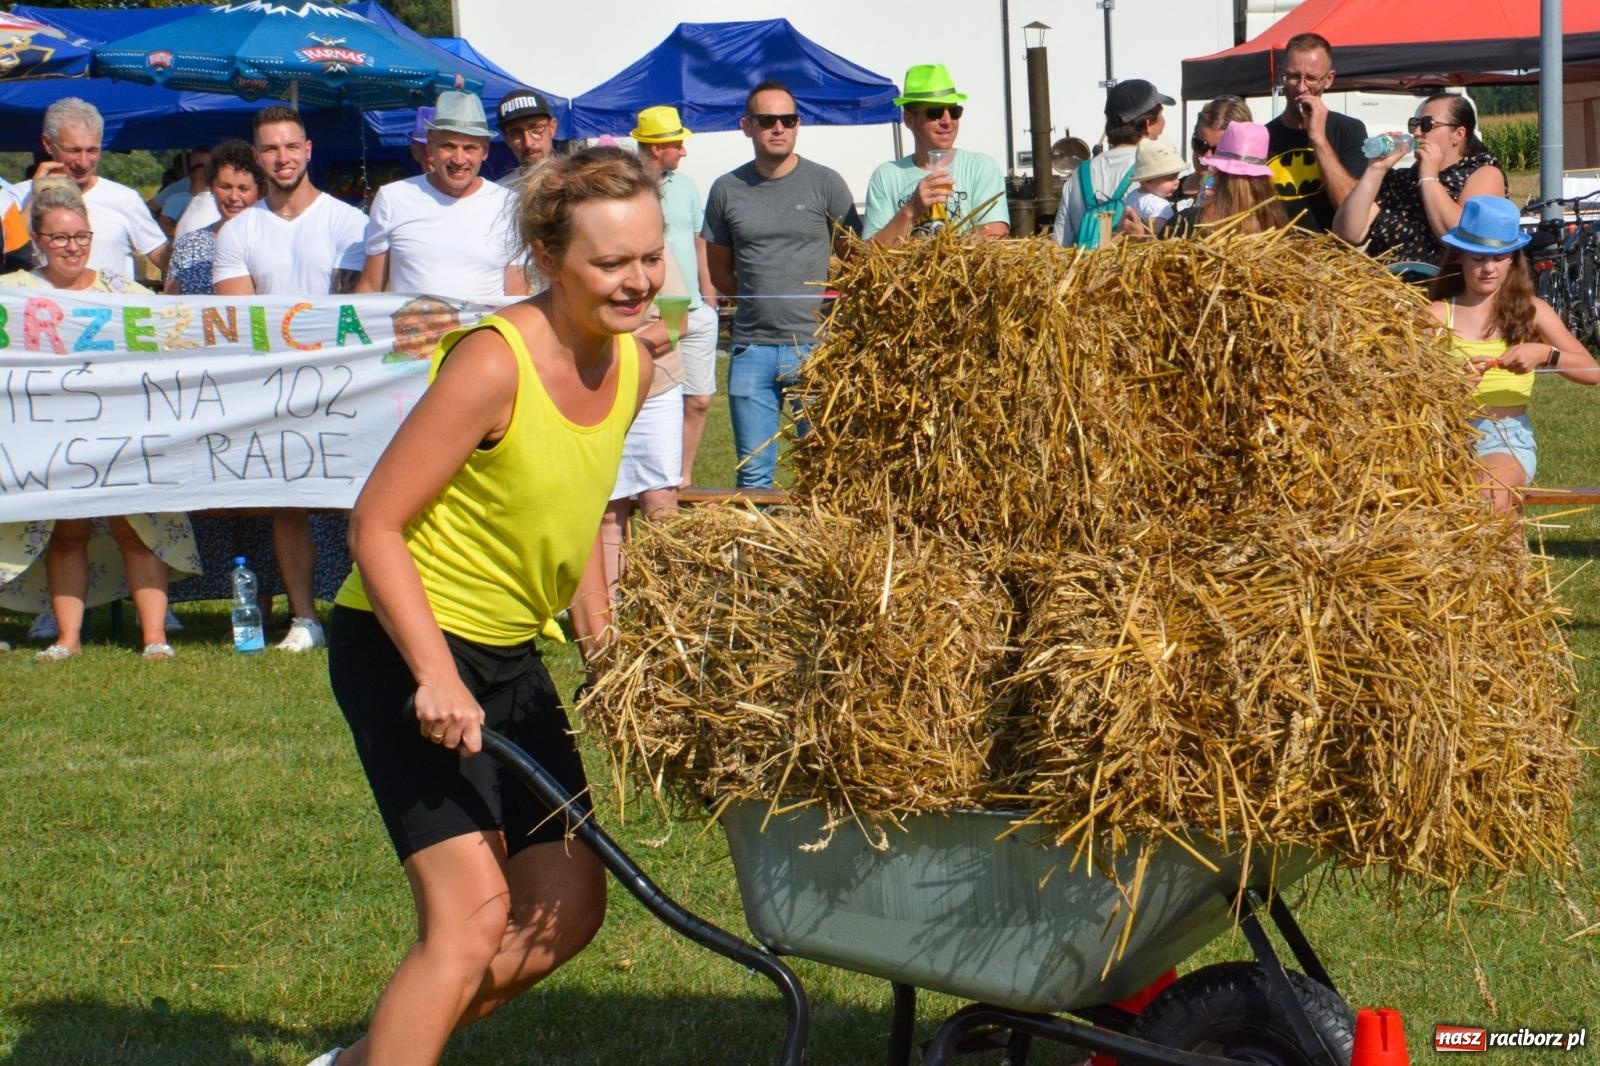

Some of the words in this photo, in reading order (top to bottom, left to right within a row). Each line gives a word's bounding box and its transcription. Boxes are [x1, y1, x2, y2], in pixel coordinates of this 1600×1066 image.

[501, 96, 537, 116] PUMA
[142, 369, 225, 421] NA
[263, 365, 357, 418] 102
[0, 434, 179, 492] WSZE
